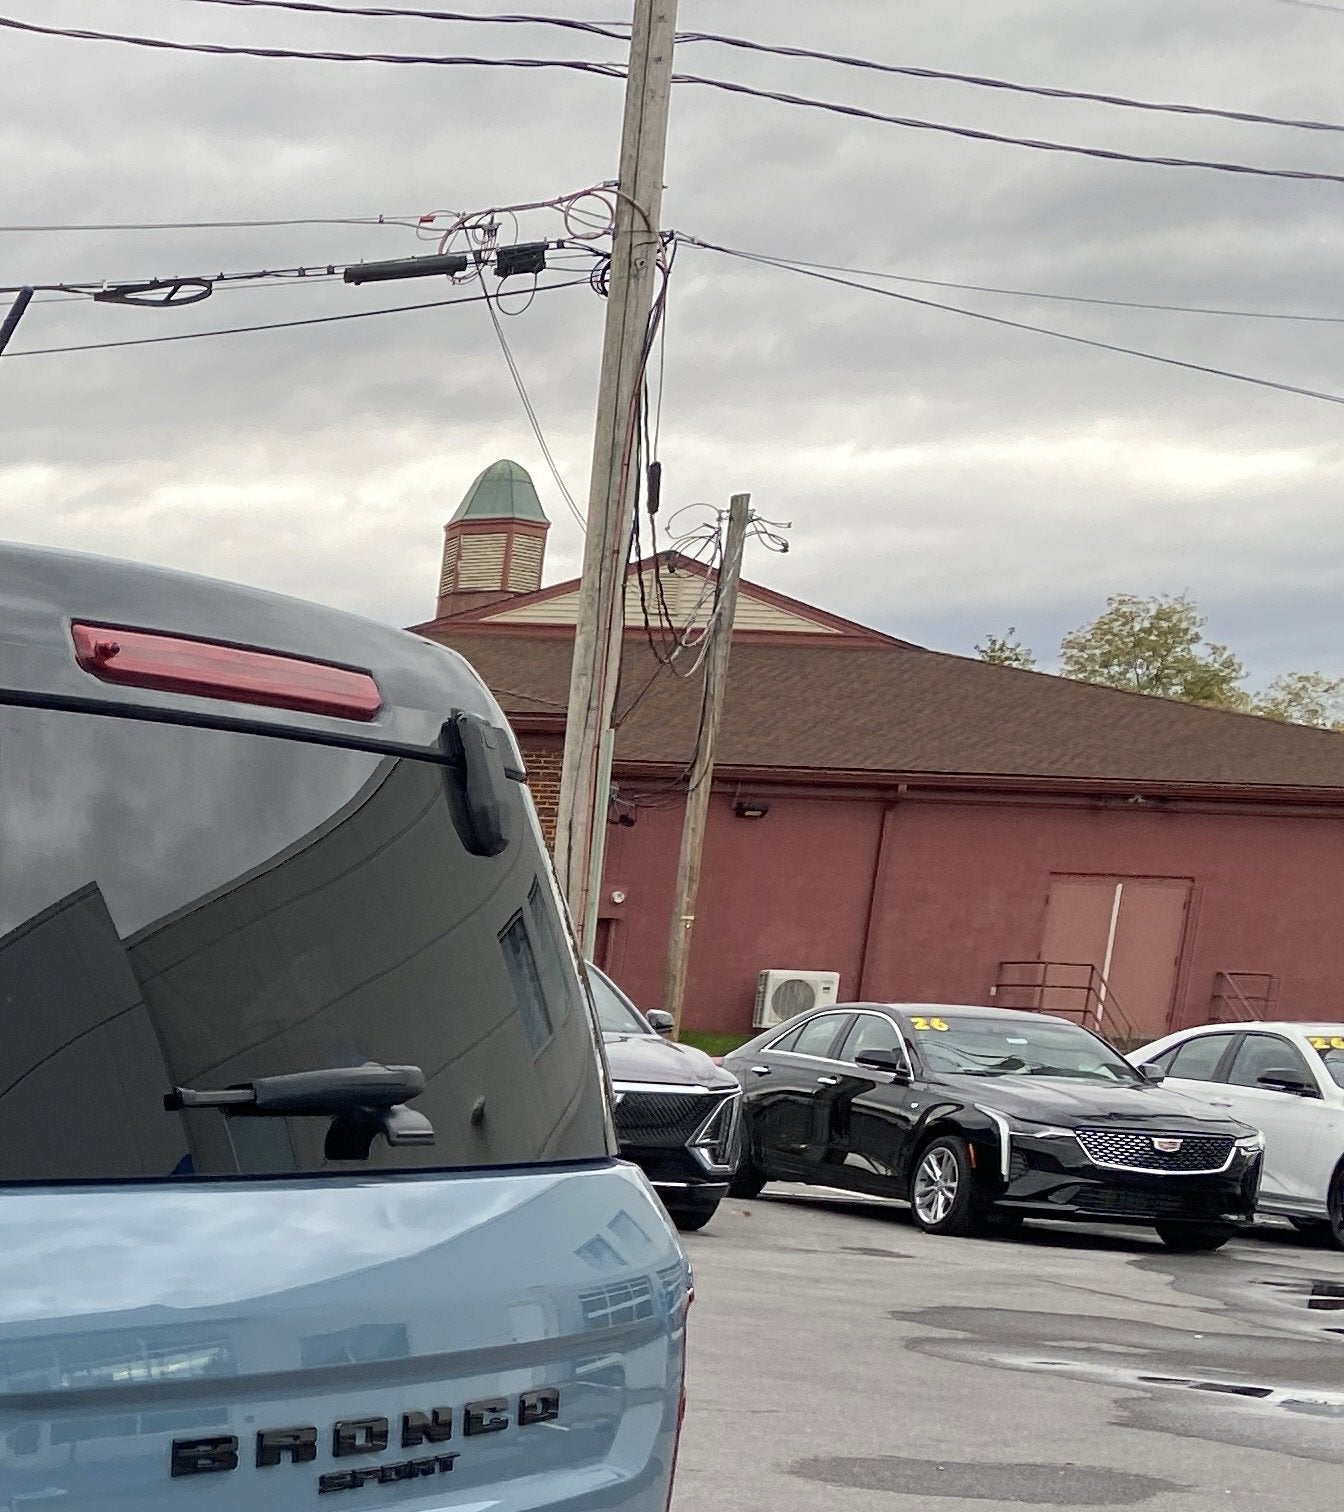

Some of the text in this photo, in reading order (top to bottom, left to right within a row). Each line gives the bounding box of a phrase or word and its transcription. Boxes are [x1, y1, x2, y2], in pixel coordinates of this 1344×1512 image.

[910, 1017, 950, 1031] 26
[171, 1388, 560, 1478] BRONCO
[318, 1451, 461, 1494] SPORT
